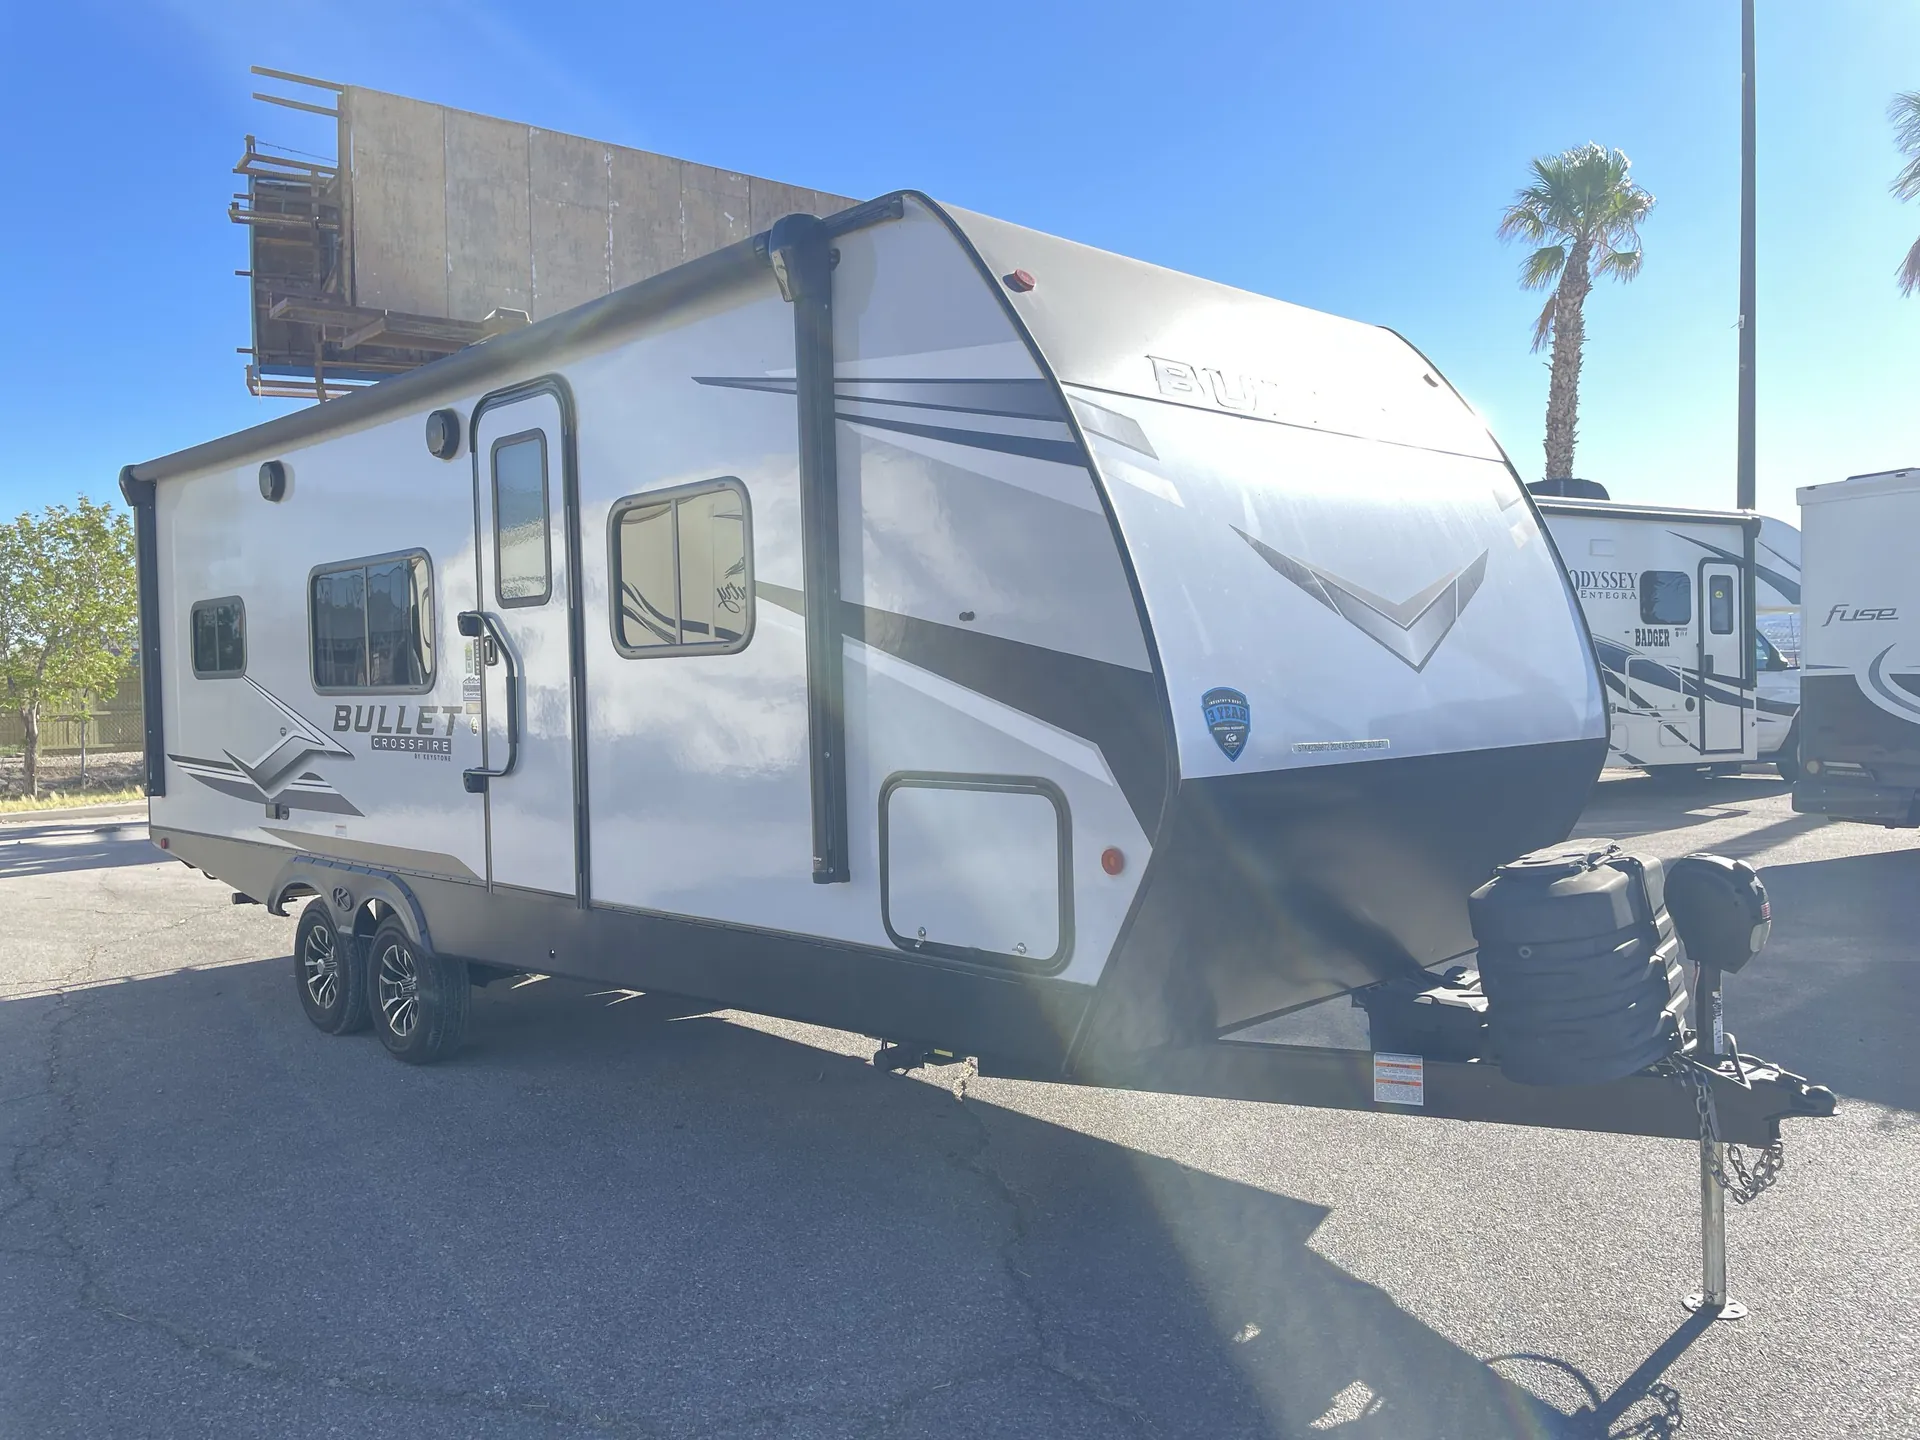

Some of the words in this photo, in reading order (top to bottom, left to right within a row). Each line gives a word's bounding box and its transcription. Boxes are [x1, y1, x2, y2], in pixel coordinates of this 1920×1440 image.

[1580, 590, 1637, 600] ENTEGRA
[1821, 603, 1899, 627] fuse
[1635, 628, 1670, 647] BADGER
[333, 705, 462, 736] BULLET
[1207, 709, 1216, 722] 3
[1216, 705, 1247, 721] YEAR
[372, 738, 449, 752] CROSSFIRE
[423, 753, 451, 761] KEYSTONE
